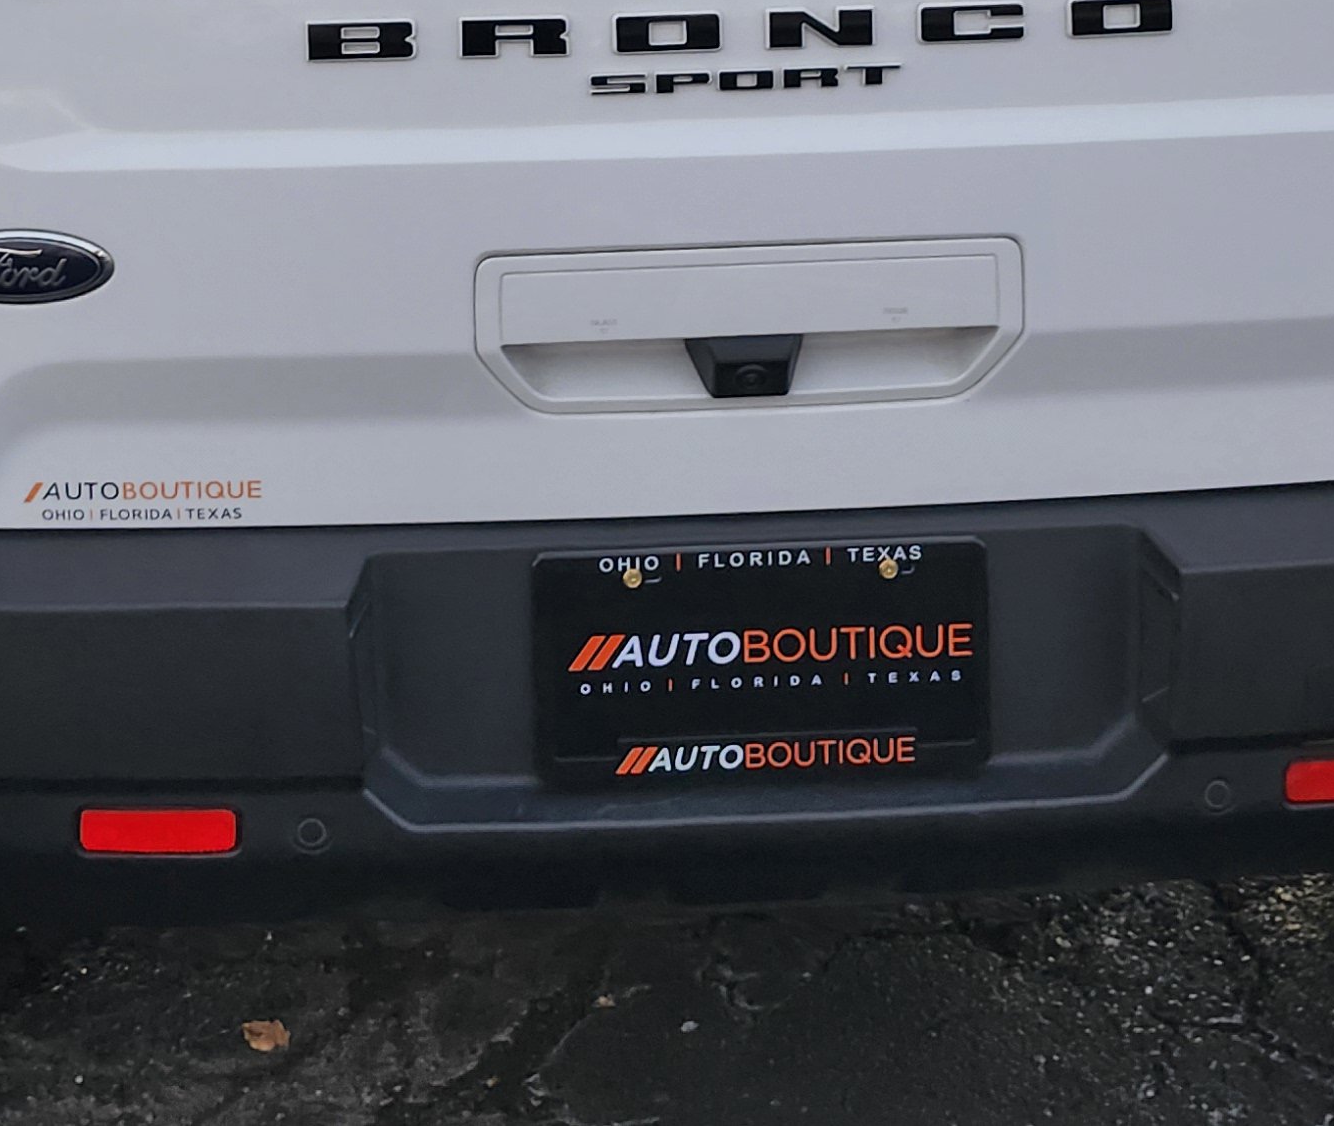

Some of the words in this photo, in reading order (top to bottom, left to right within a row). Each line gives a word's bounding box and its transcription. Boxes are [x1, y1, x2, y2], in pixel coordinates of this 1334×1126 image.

[589, 63, 901, 95] SPORT
[41, 480, 263, 502] AUTOBOUTIQUE
[42, 509, 85, 521] OHIO
[100, 508, 172, 521] FLORIDA
[185, 508, 243, 521] TEXAS
[599, 555, 660, 573] OHIO
[698, 548, 812, 570] FLORIDA
[847, 545, 923, 564] TEXAS
[612, 623, 974, 669] AUTOBOUTIQUE
[579, 680, 652, 695] OHIO
[691, 674, 823, 690] FLORIDA
[867, 670, 963, 685] TEXAS
[648, 736, 916, 773] AUTOBOUTIQUE
